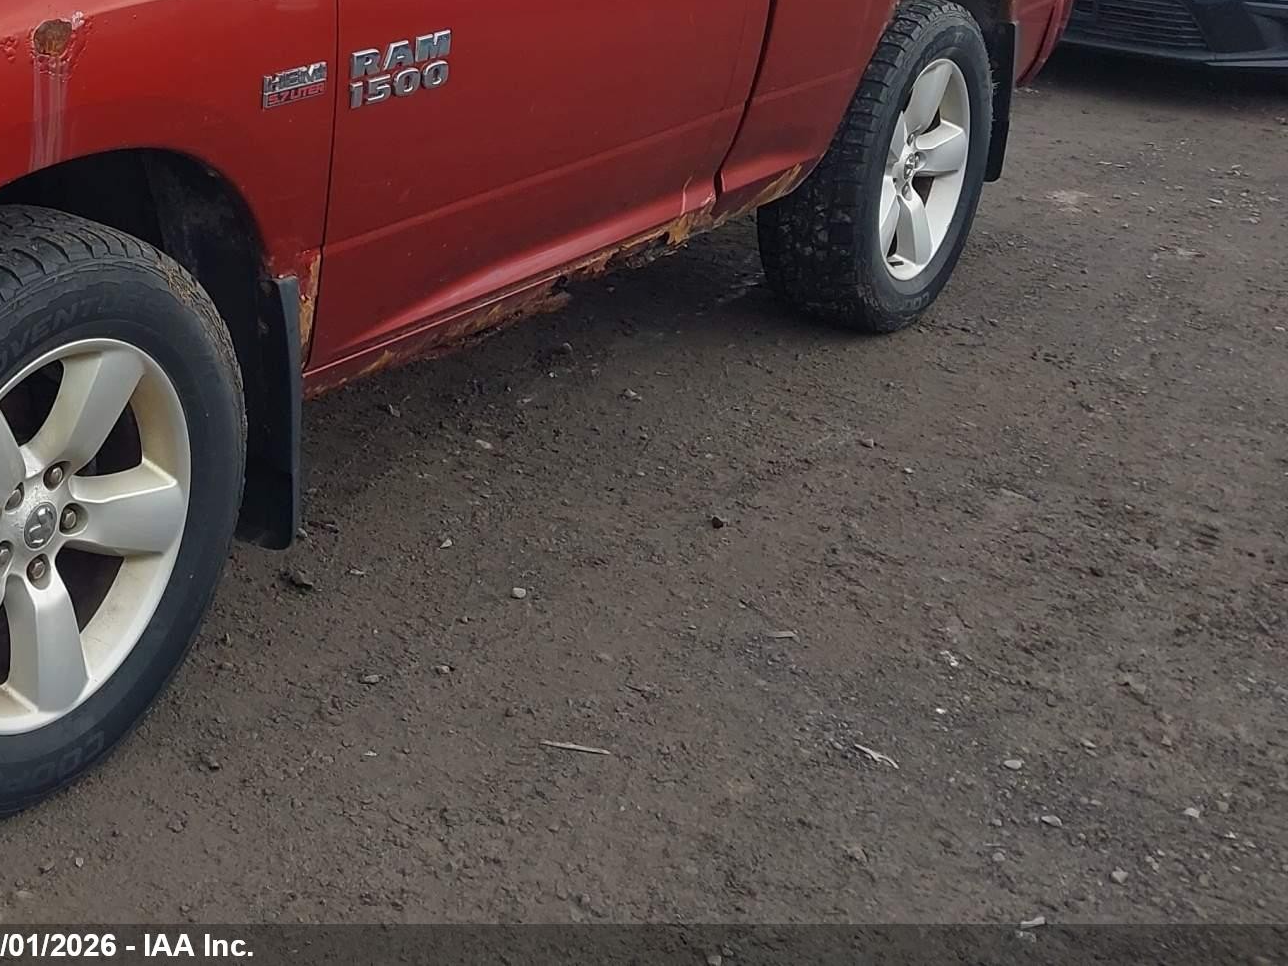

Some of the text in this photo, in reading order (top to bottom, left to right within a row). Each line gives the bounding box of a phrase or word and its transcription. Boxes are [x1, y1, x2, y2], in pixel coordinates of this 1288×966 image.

[263, 61, 328, 94] HEMI
[350, 29, 452, 78] RAM
[349, 60, 450, 110] 1500
